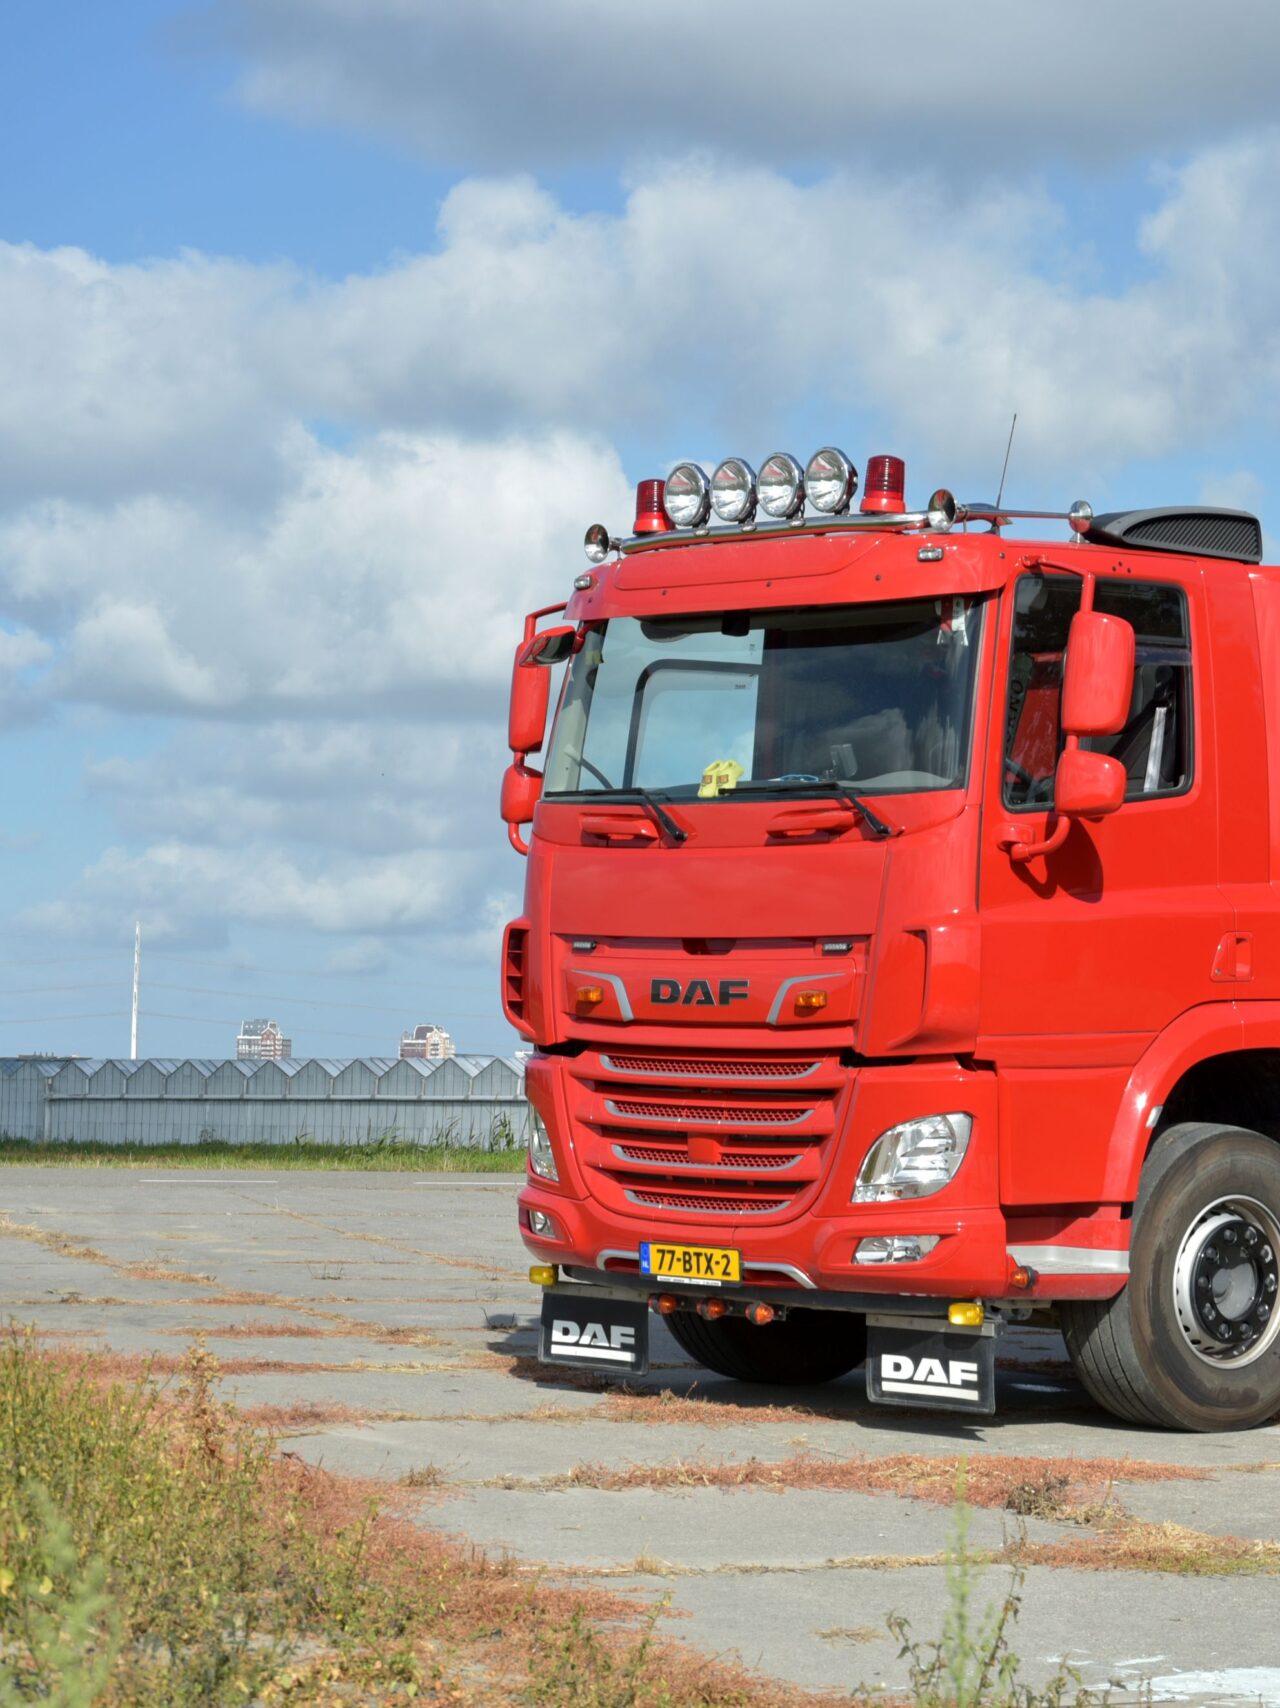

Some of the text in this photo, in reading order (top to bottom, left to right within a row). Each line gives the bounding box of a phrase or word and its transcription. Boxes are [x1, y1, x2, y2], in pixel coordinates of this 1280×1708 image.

[649, 977, 750, 1007] DAF
[656, 1249, 732, 1277] 77-BTX-2
[551, 1319, 635, 1350] DAF
[881, 1354, 978, 1386] DAF
